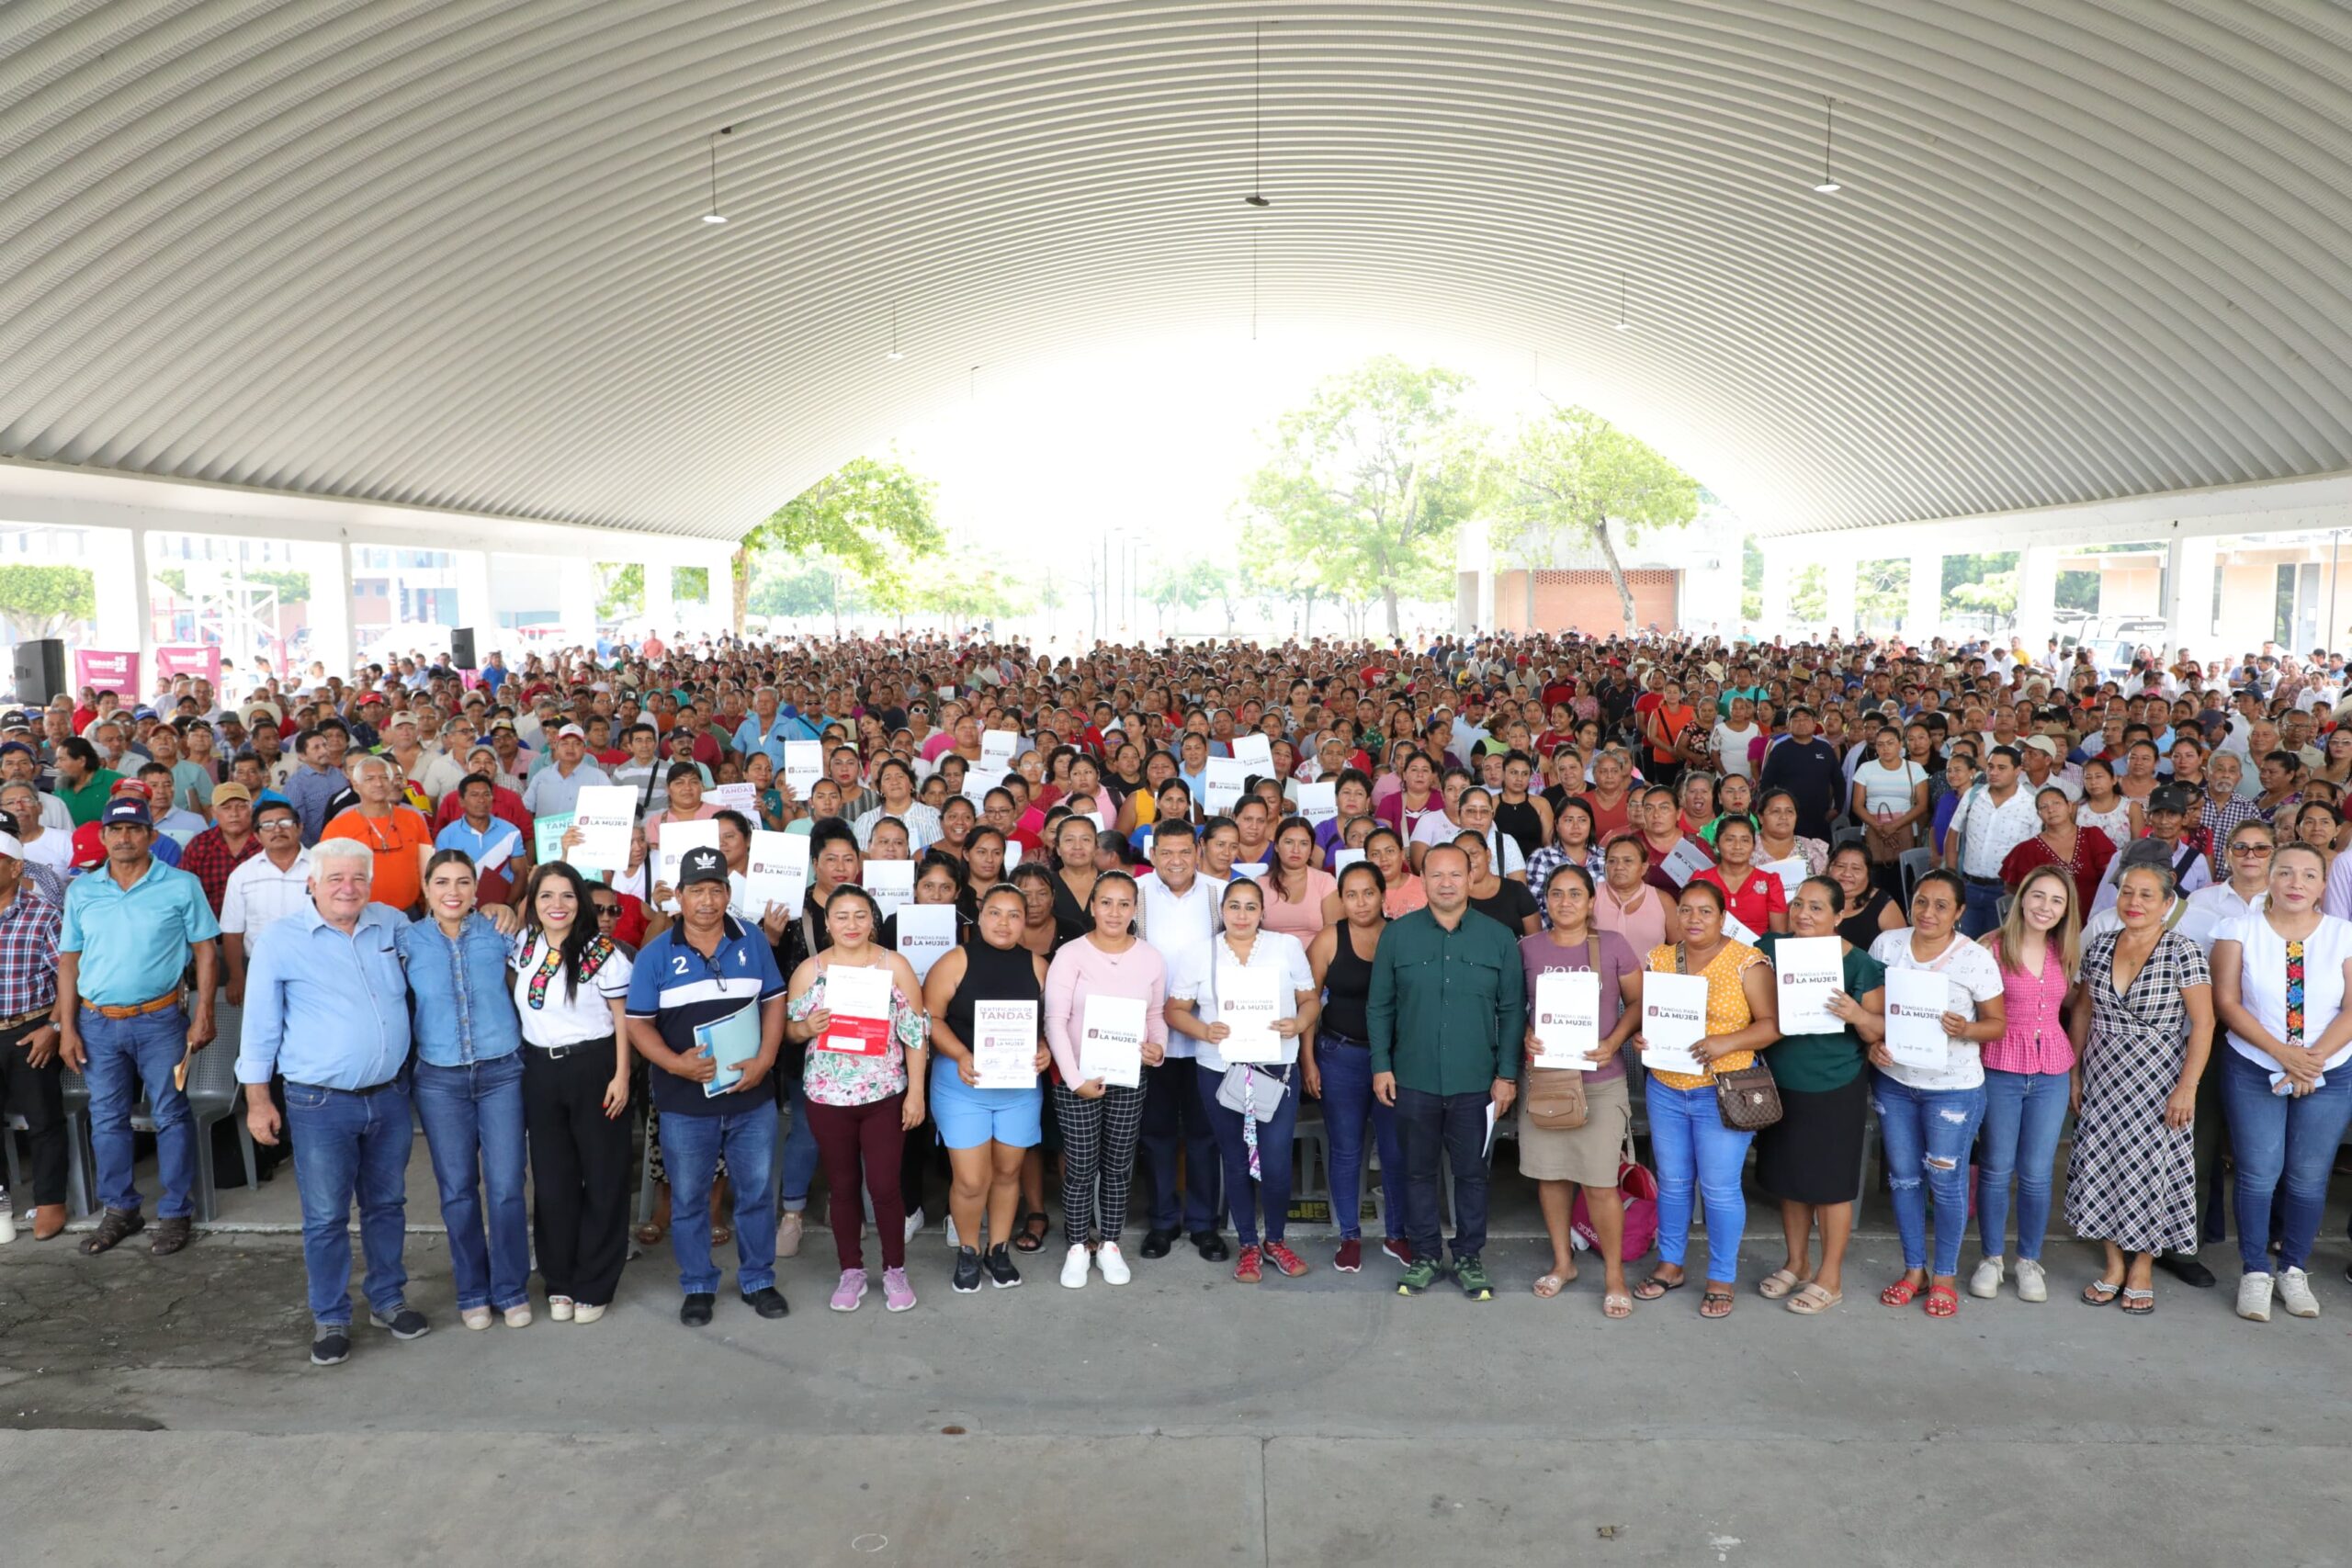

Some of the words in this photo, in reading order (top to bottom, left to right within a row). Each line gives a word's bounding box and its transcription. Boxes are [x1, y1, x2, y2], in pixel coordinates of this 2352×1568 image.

[673, 956, 689, 975] 2
[981, 1012, 1033, 1021] TANDAS
[1913, 1011, 1941, 1021] MUJER
[1111, 1035, 1137, 1043] MUJER
